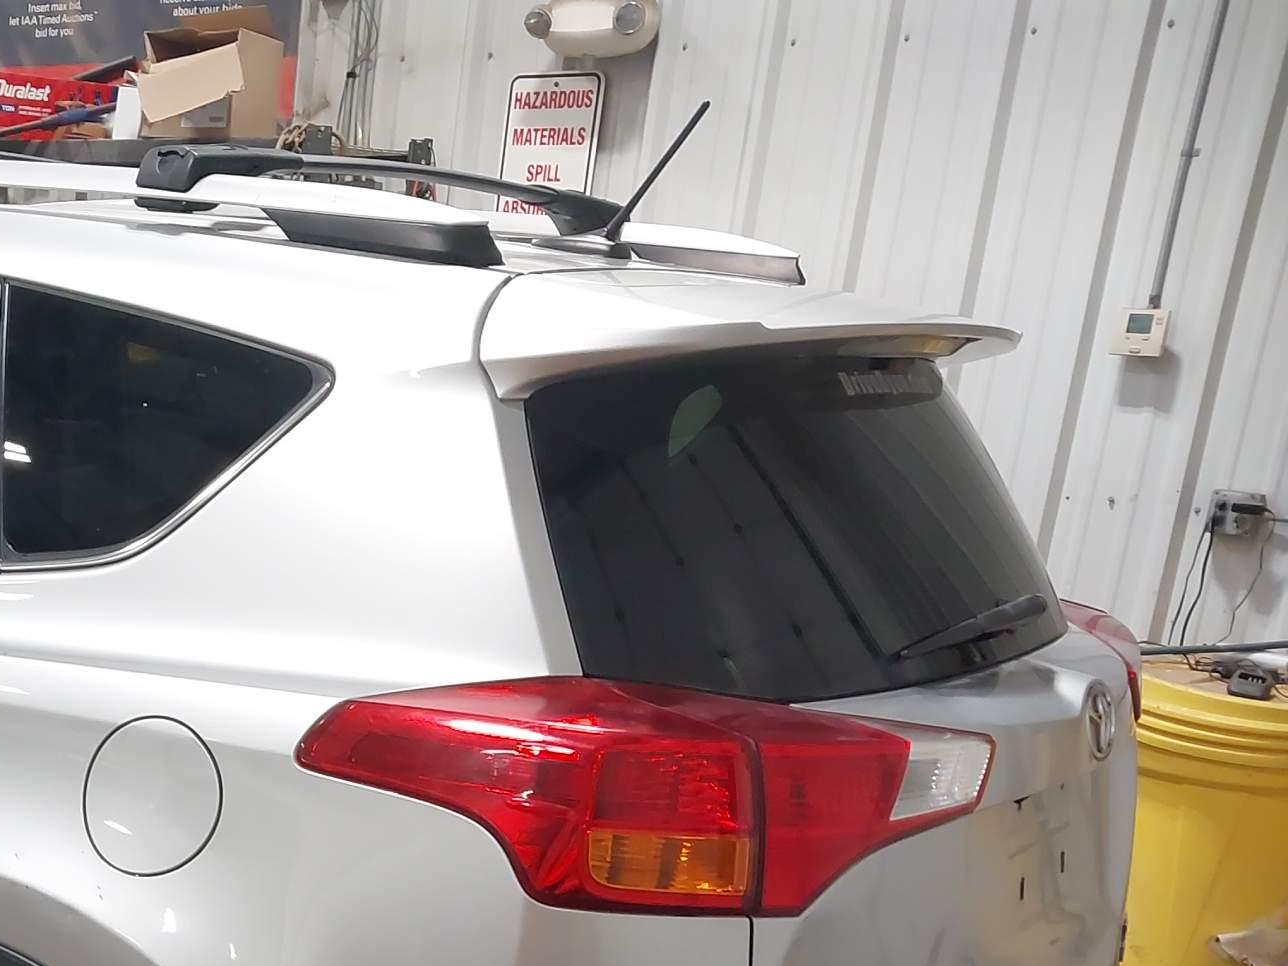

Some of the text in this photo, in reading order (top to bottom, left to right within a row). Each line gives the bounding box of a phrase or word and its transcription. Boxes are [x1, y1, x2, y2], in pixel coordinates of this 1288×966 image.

[28, 3, 50, 14] Insert
[51, 4, 67, 12] max
[173, 6, 198, 17] about
[9, 16, 20, 27] let
[21, 15, 38, 26] IAA
[39, 14, 60, 25] Timed
[35, 27, 74, 38] bid for you
[514, 90, 594, 109] HAZARDOUS
[511, 127, 587, 146] MATERIALS
[526, 164, 561, 183] SPILL
